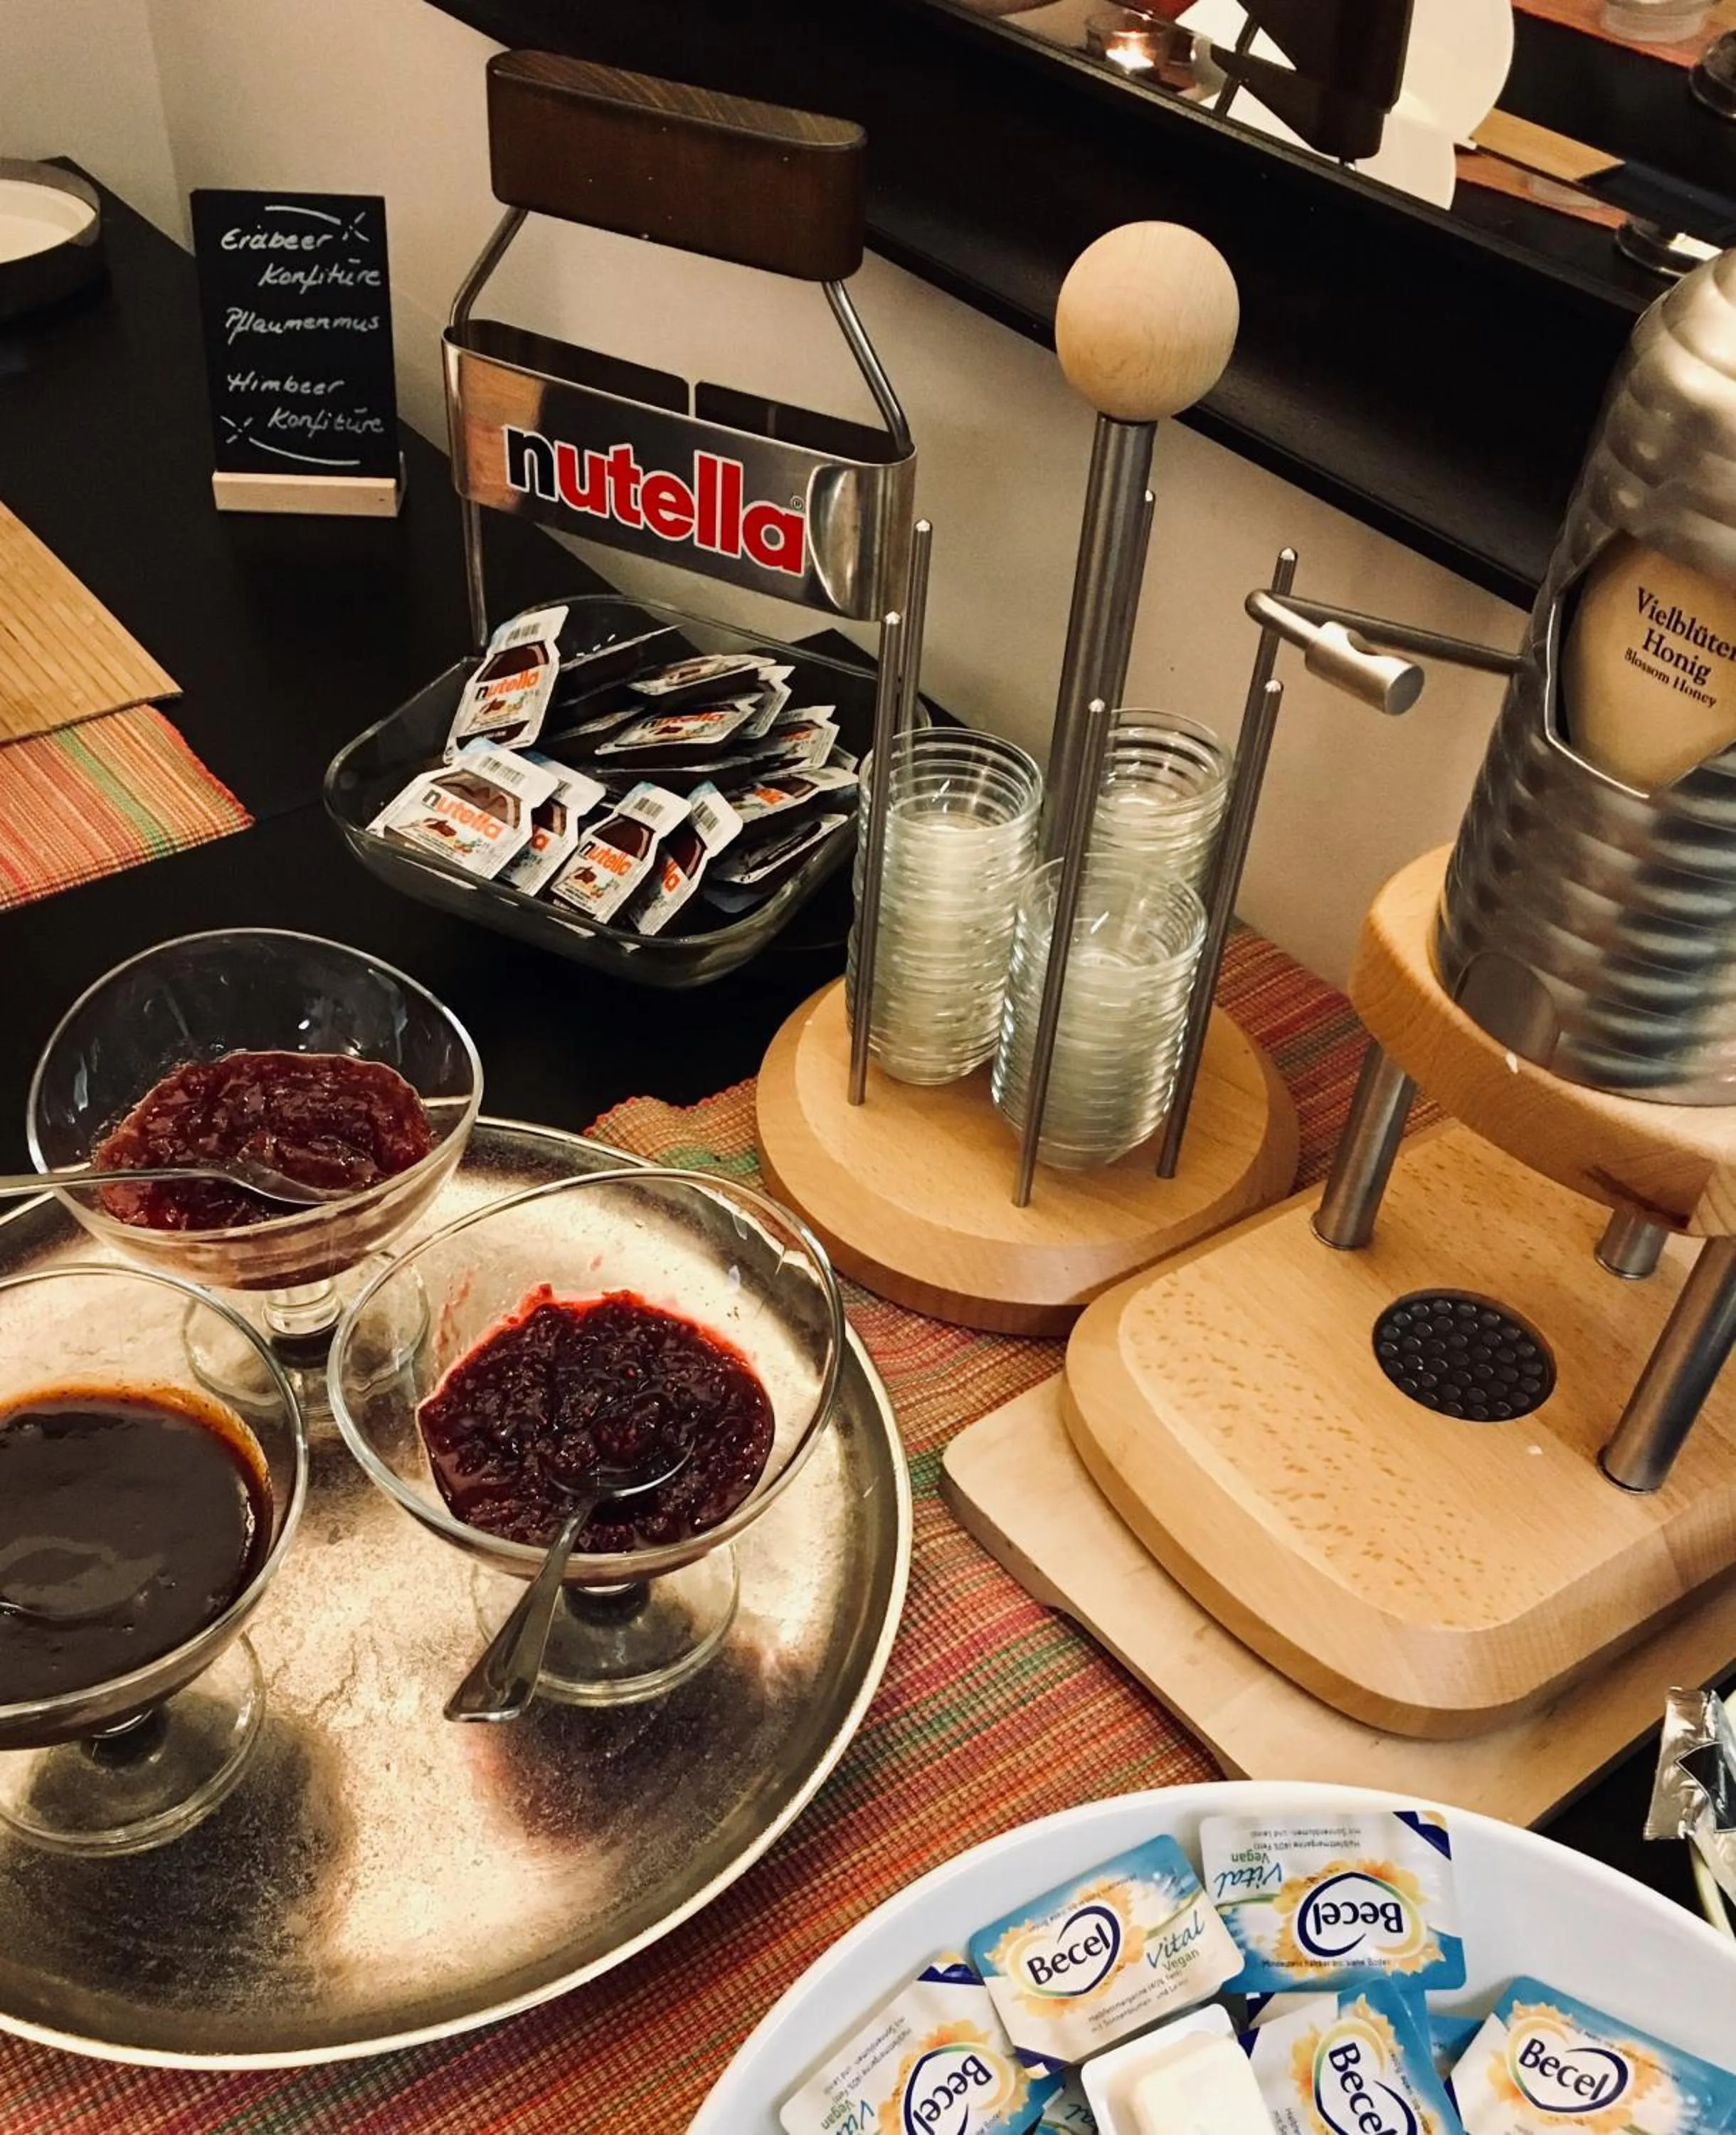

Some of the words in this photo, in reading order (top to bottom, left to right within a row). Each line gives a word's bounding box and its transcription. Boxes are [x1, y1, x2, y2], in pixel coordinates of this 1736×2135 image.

[225, 307, 379, 346] Pflaumenmus
[227, 371, 345, 396] Himbeer
[502, 424, 805, 576] nutella
[1642, 628, 1711, 685] Honig
[475, 670, 539, 700] nutella
[1624, 646, 1670, 685] Blossom
[1673, 676, 1717, 709] Honey
[422, 789, 502, 840] nutella
[578, 840, 633, 876] nutella
[1231, 1850, 1270, 1863] Vegan
[1214, 1862, 1282, 1899] Vital
[1313, 1902, 1404, 1936] Becel
[1027, 1923, 1110, 1985] Becel
[1147, 1910, 1205, 1968] Vital
[1162, 1949, 1200, 1971] Vegan
[1519, 2038, 1609, 2100] Becel
[821, 2099, 856, 2130] Vegan
[913, 2055, 993, 2135] Becel
